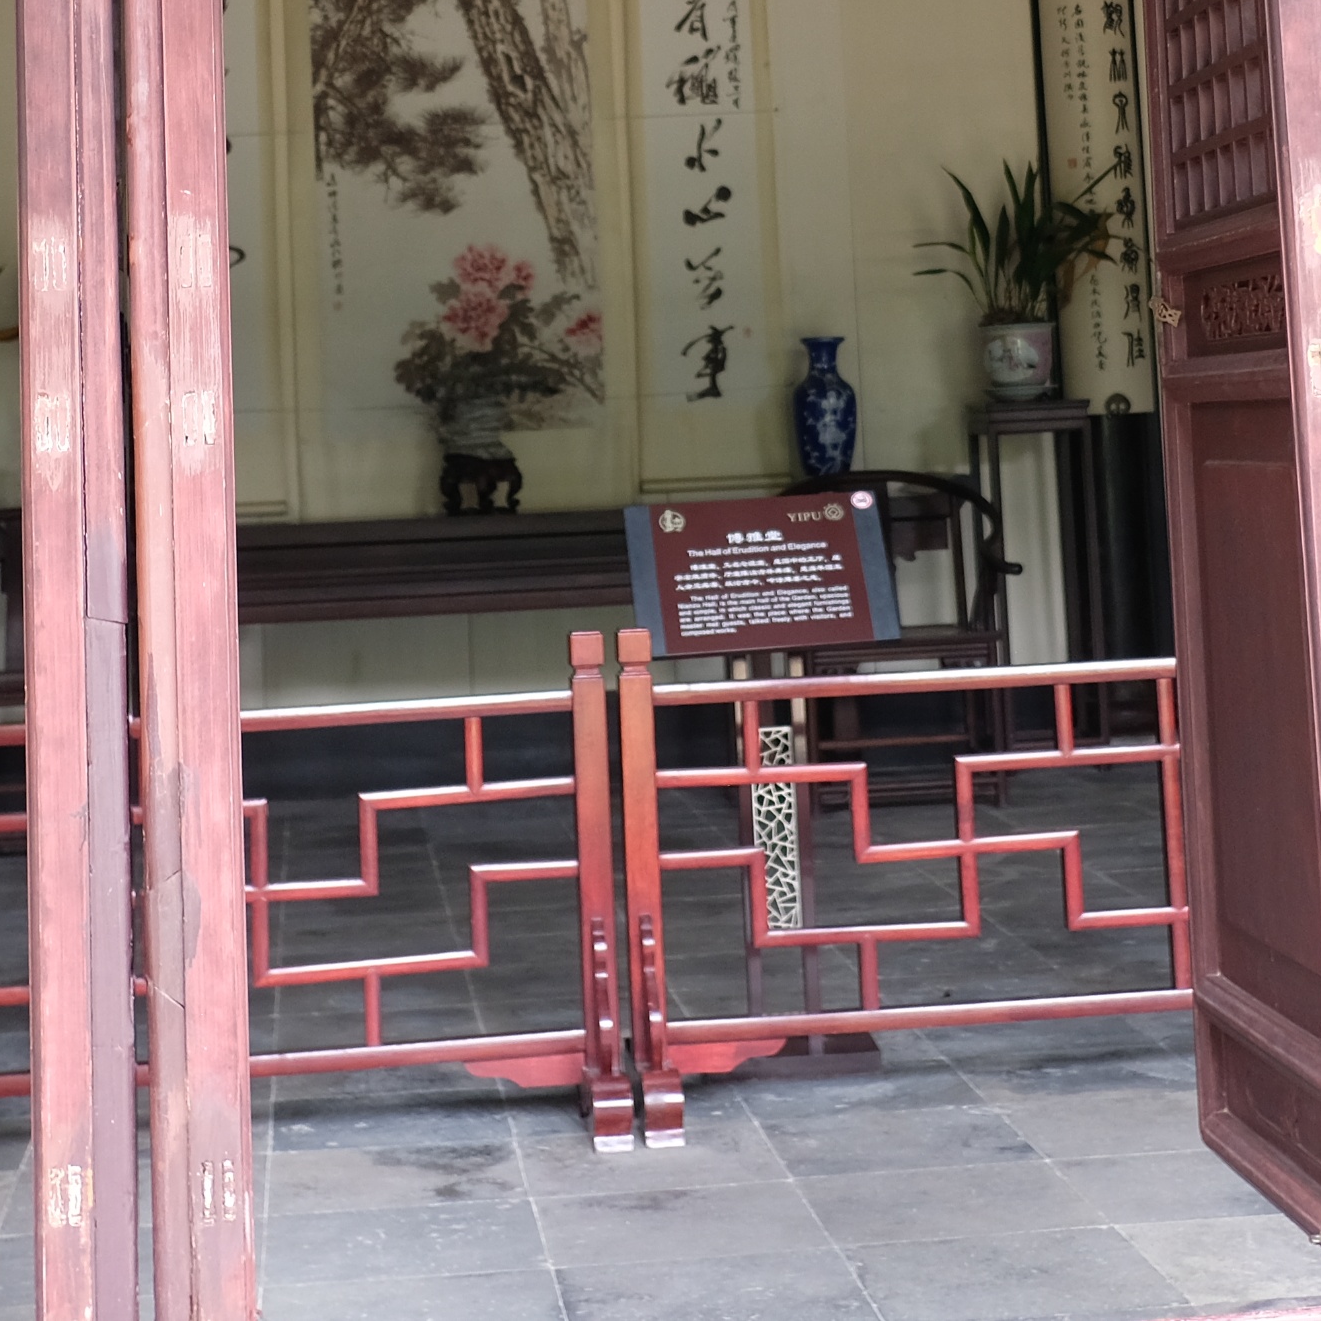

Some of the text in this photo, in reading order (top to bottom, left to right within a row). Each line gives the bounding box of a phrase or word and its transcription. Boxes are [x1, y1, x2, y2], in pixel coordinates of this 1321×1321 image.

[786, 510, 822, 523] YIPU
[687, 541, 828, 558] The Hall of Erudition and Elegance
